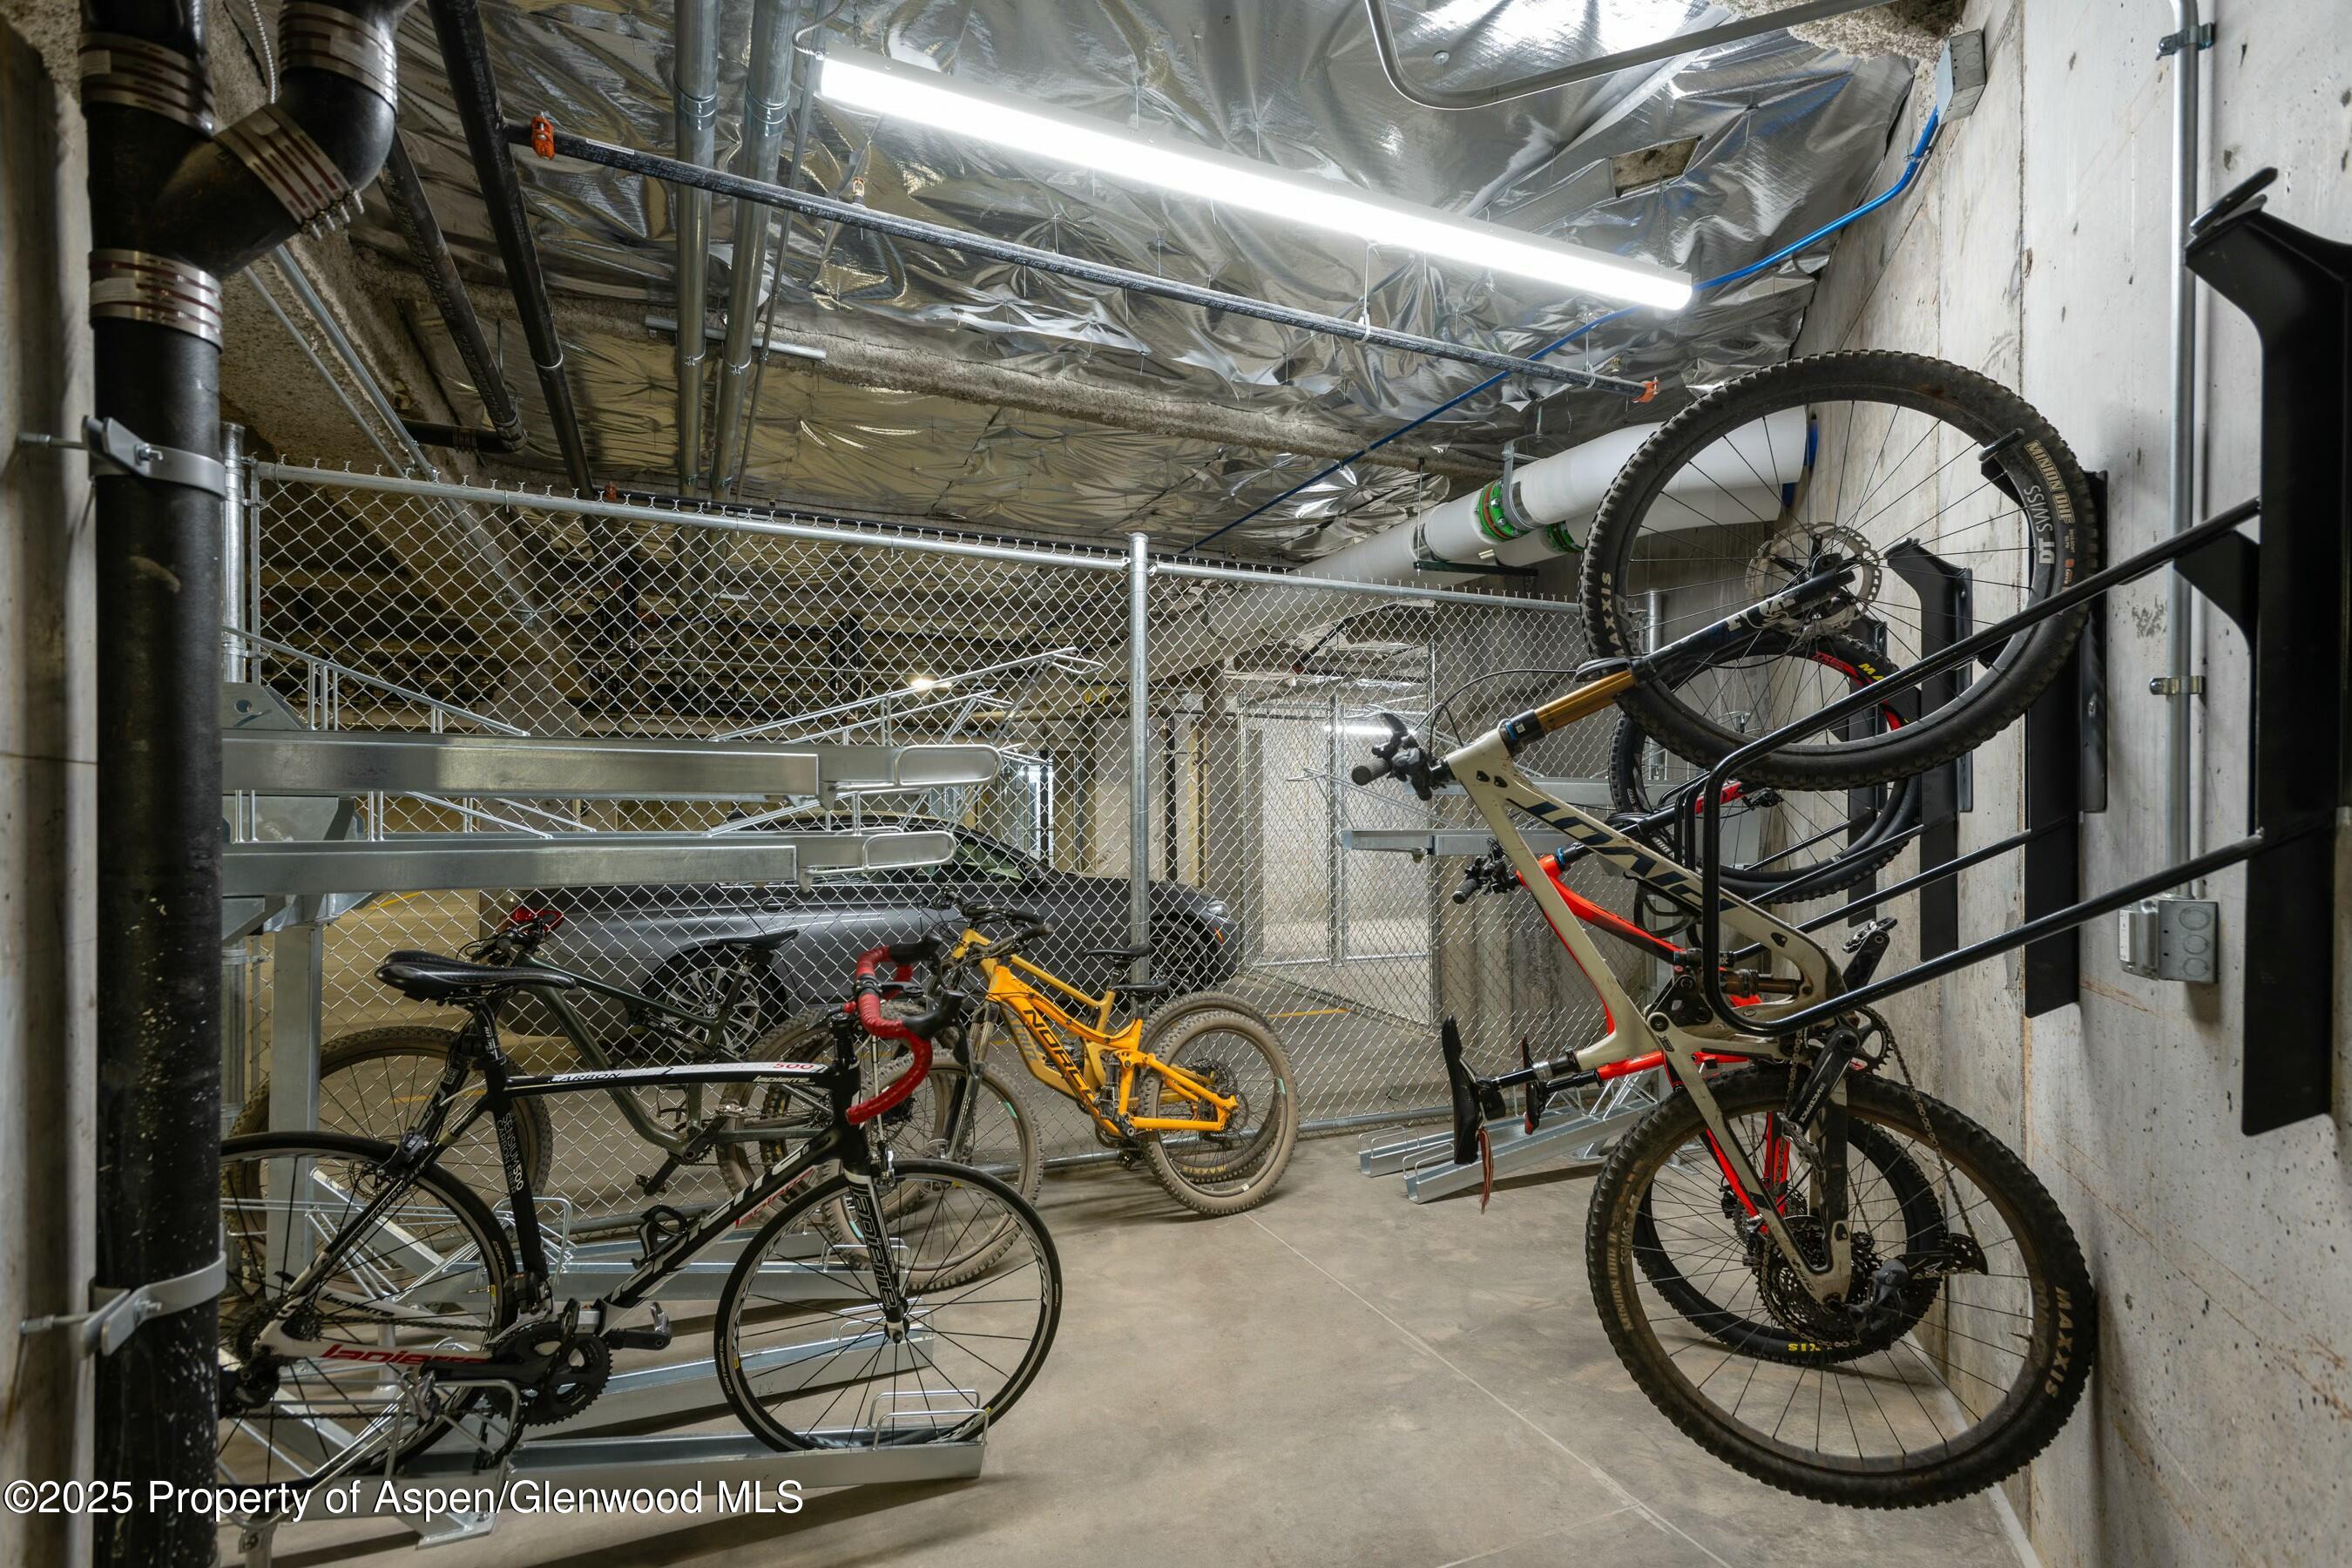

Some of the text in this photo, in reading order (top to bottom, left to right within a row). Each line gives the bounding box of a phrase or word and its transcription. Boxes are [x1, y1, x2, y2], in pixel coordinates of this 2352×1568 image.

[2024, 439, 2065, 491] MINION
[2051, 492, 2075, 524] DHF
[2024, 484, 2055, 564] DT SWISS
[848, 1183, 899, 1309] lapierre
[2044, 1286, 2073, 1397] MAXXIS
